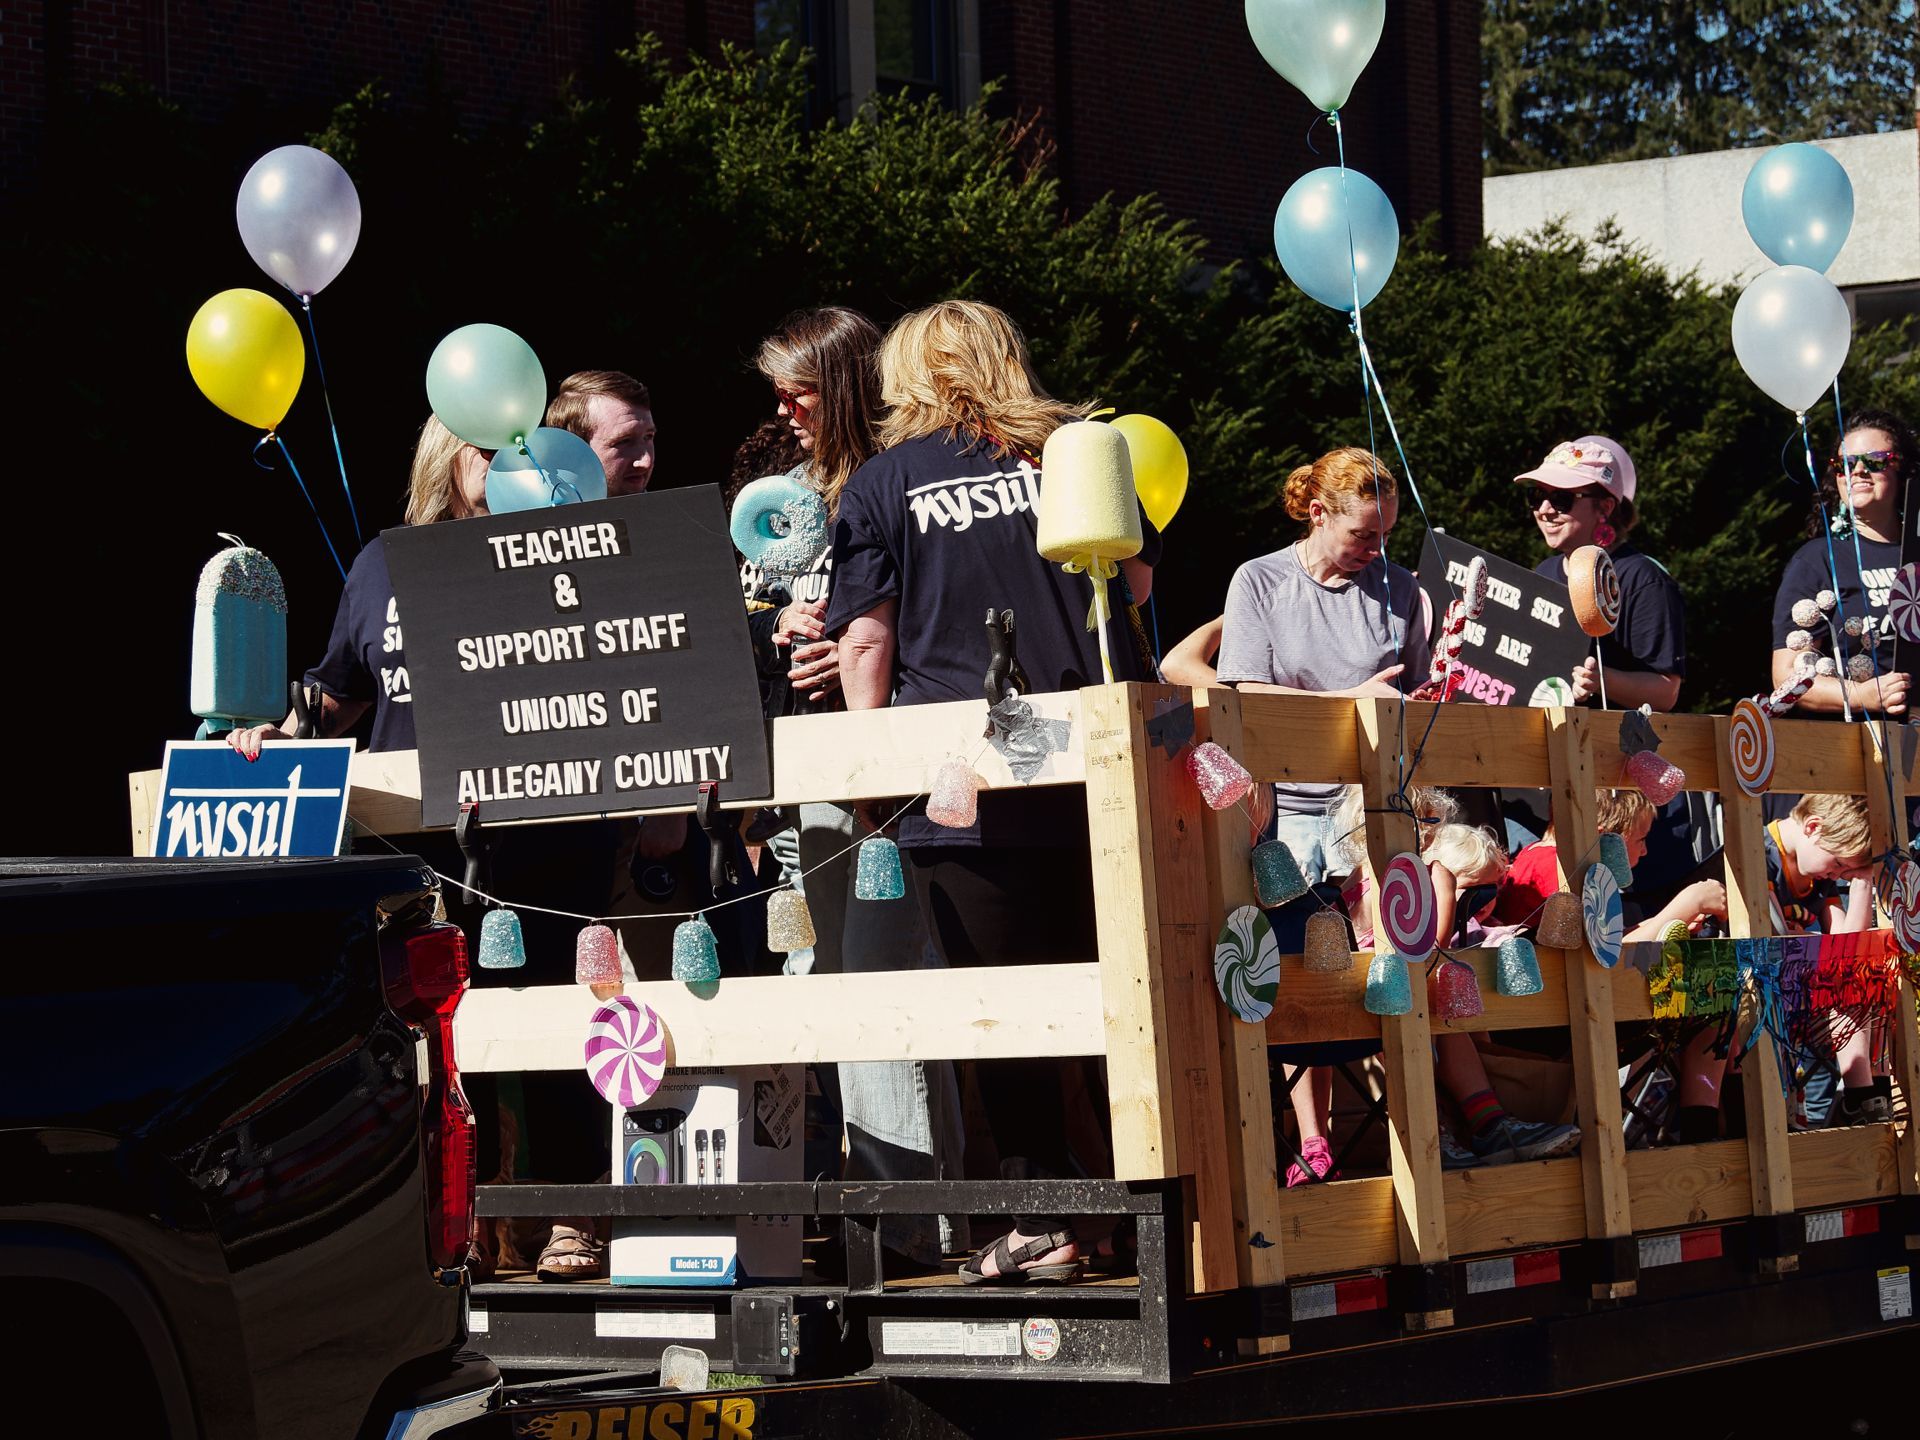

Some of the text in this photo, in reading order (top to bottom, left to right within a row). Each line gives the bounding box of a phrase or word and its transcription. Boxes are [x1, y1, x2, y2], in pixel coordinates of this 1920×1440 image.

[906, 459, 1042, 534] nysut
[488, 522, 620, 569] TEACHER
[554, 573, 579, 608] &
[1529, 596, 1564, 628] SIX
[457, 613, 687, 672] SUPPORT STAFF
[1495, 634, 1532, 667] ARE
[501, 687, 658, 734] UNIONS OF
[458, 746, 730, 803] ALLEGANY COUNTY
[691, 1066, 725, 1076] MACHINE
[675, 1259, 718, 1269] Model: T-03
